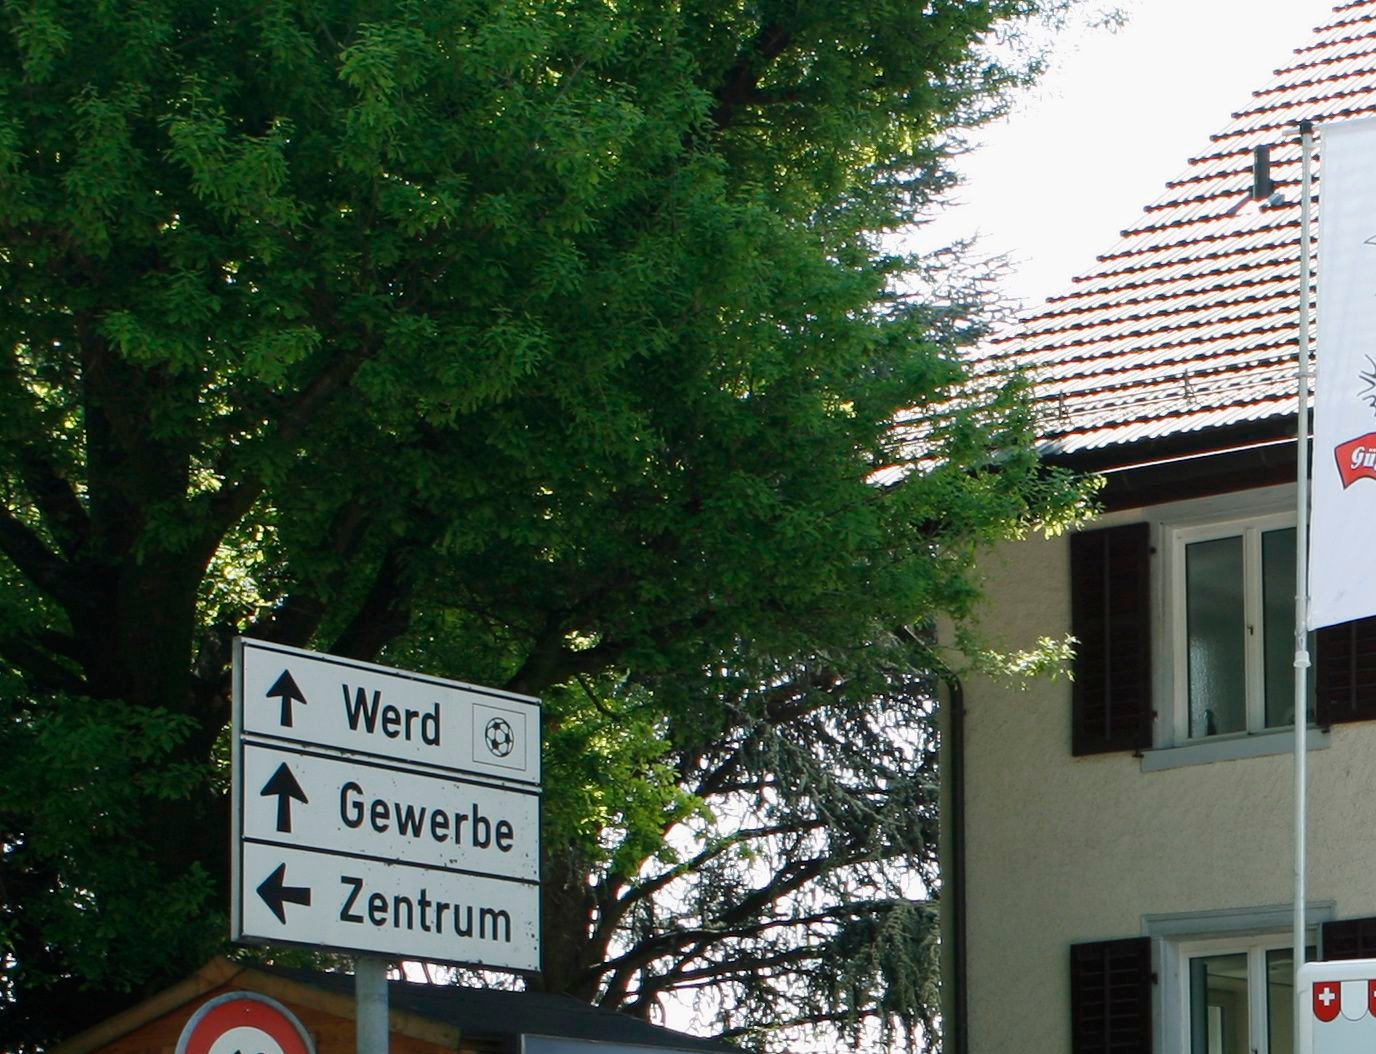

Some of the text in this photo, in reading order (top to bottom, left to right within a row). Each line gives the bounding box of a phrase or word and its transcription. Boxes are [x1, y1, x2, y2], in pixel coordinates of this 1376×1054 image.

[341, 683, 441, 747] Werd
[340, 781, 514, 852] Gewerbe
[339, 875, 512, 943] Zentrum
